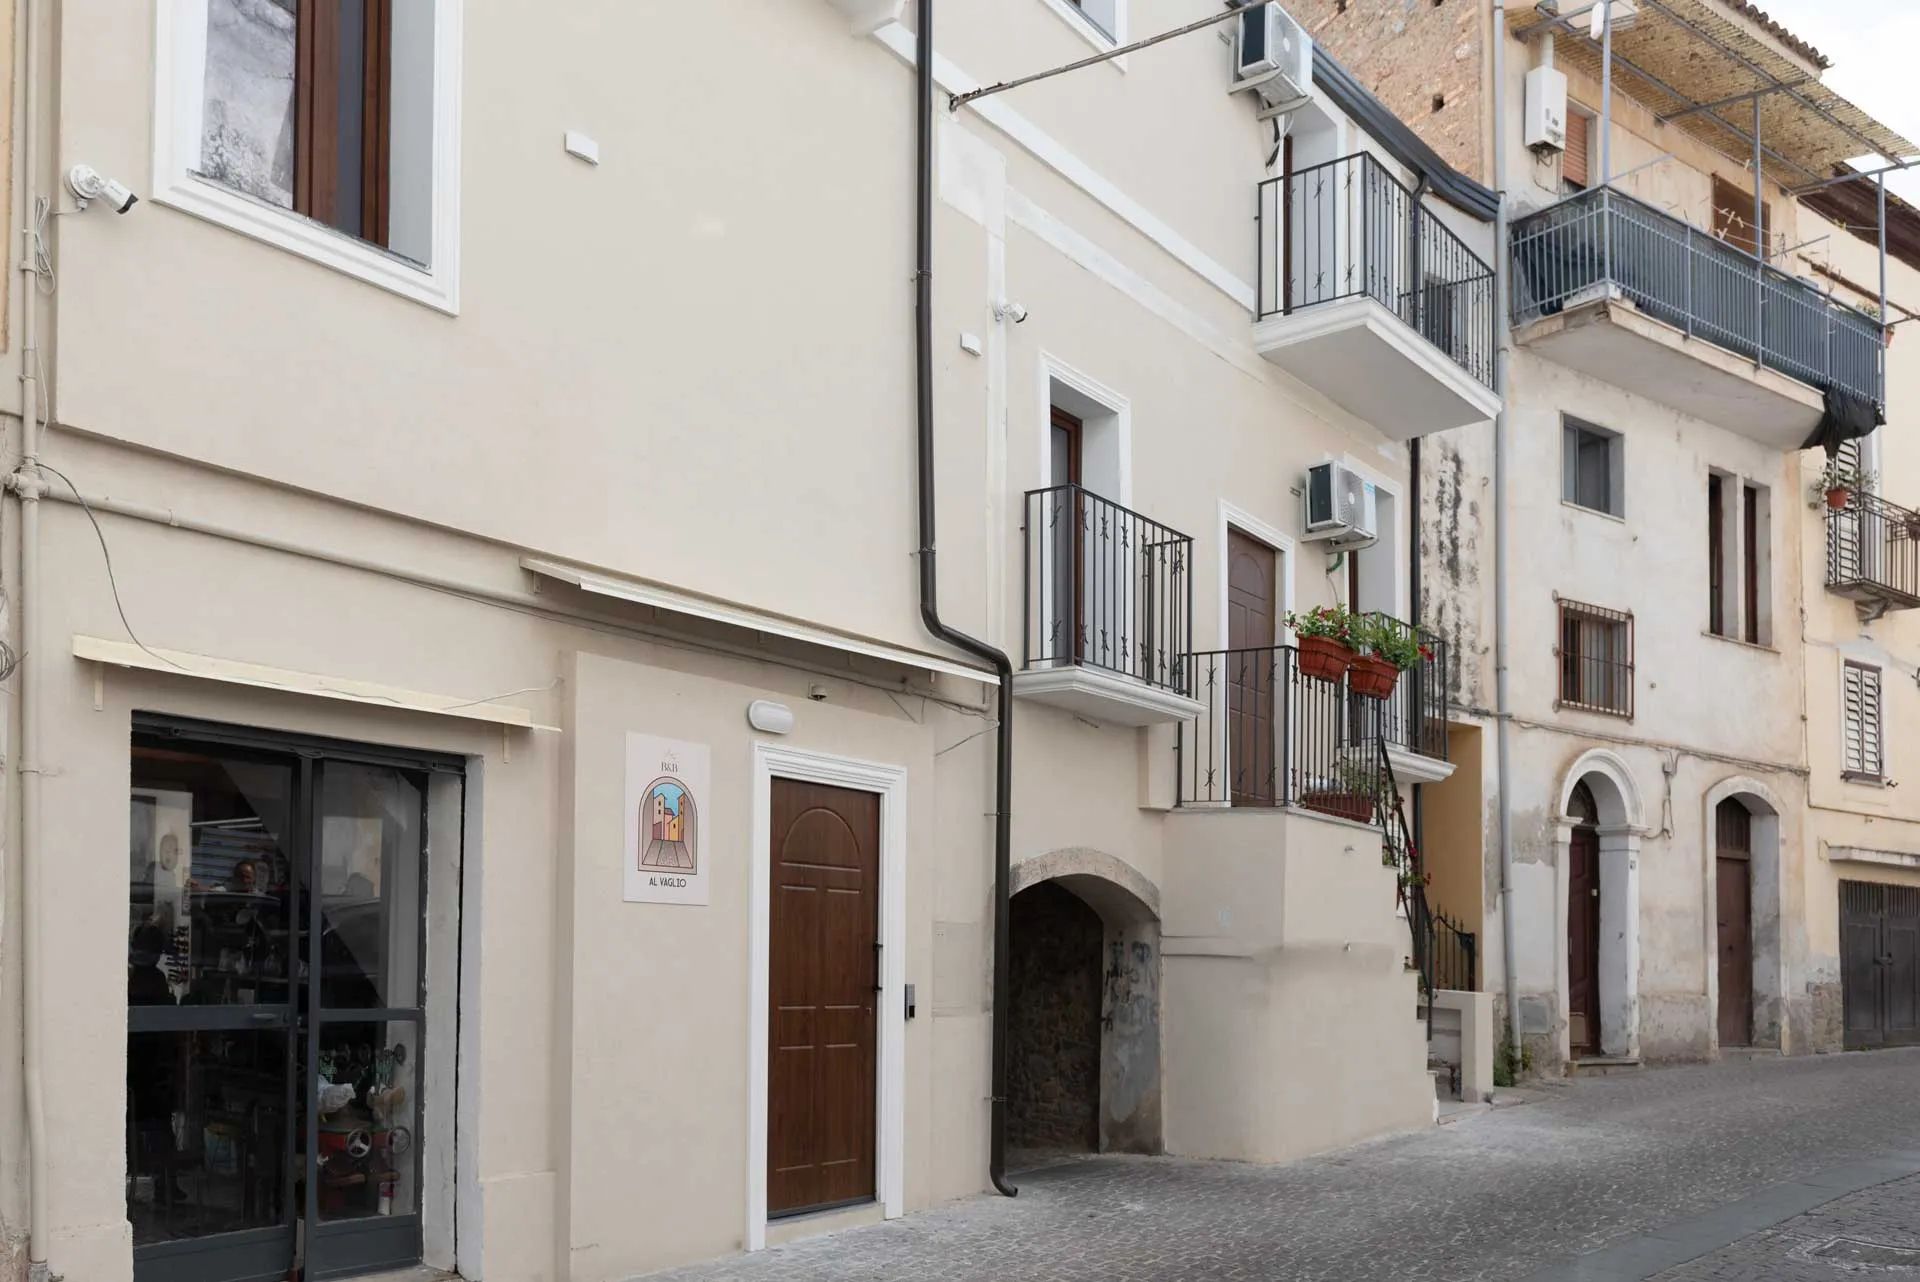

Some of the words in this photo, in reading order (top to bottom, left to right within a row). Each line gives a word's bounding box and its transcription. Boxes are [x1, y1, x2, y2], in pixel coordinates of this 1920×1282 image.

[661, 761, 678, 773] B&B
[649, 876, 658, 887] AL
[660, 877, 687, 888] VAGLIO
